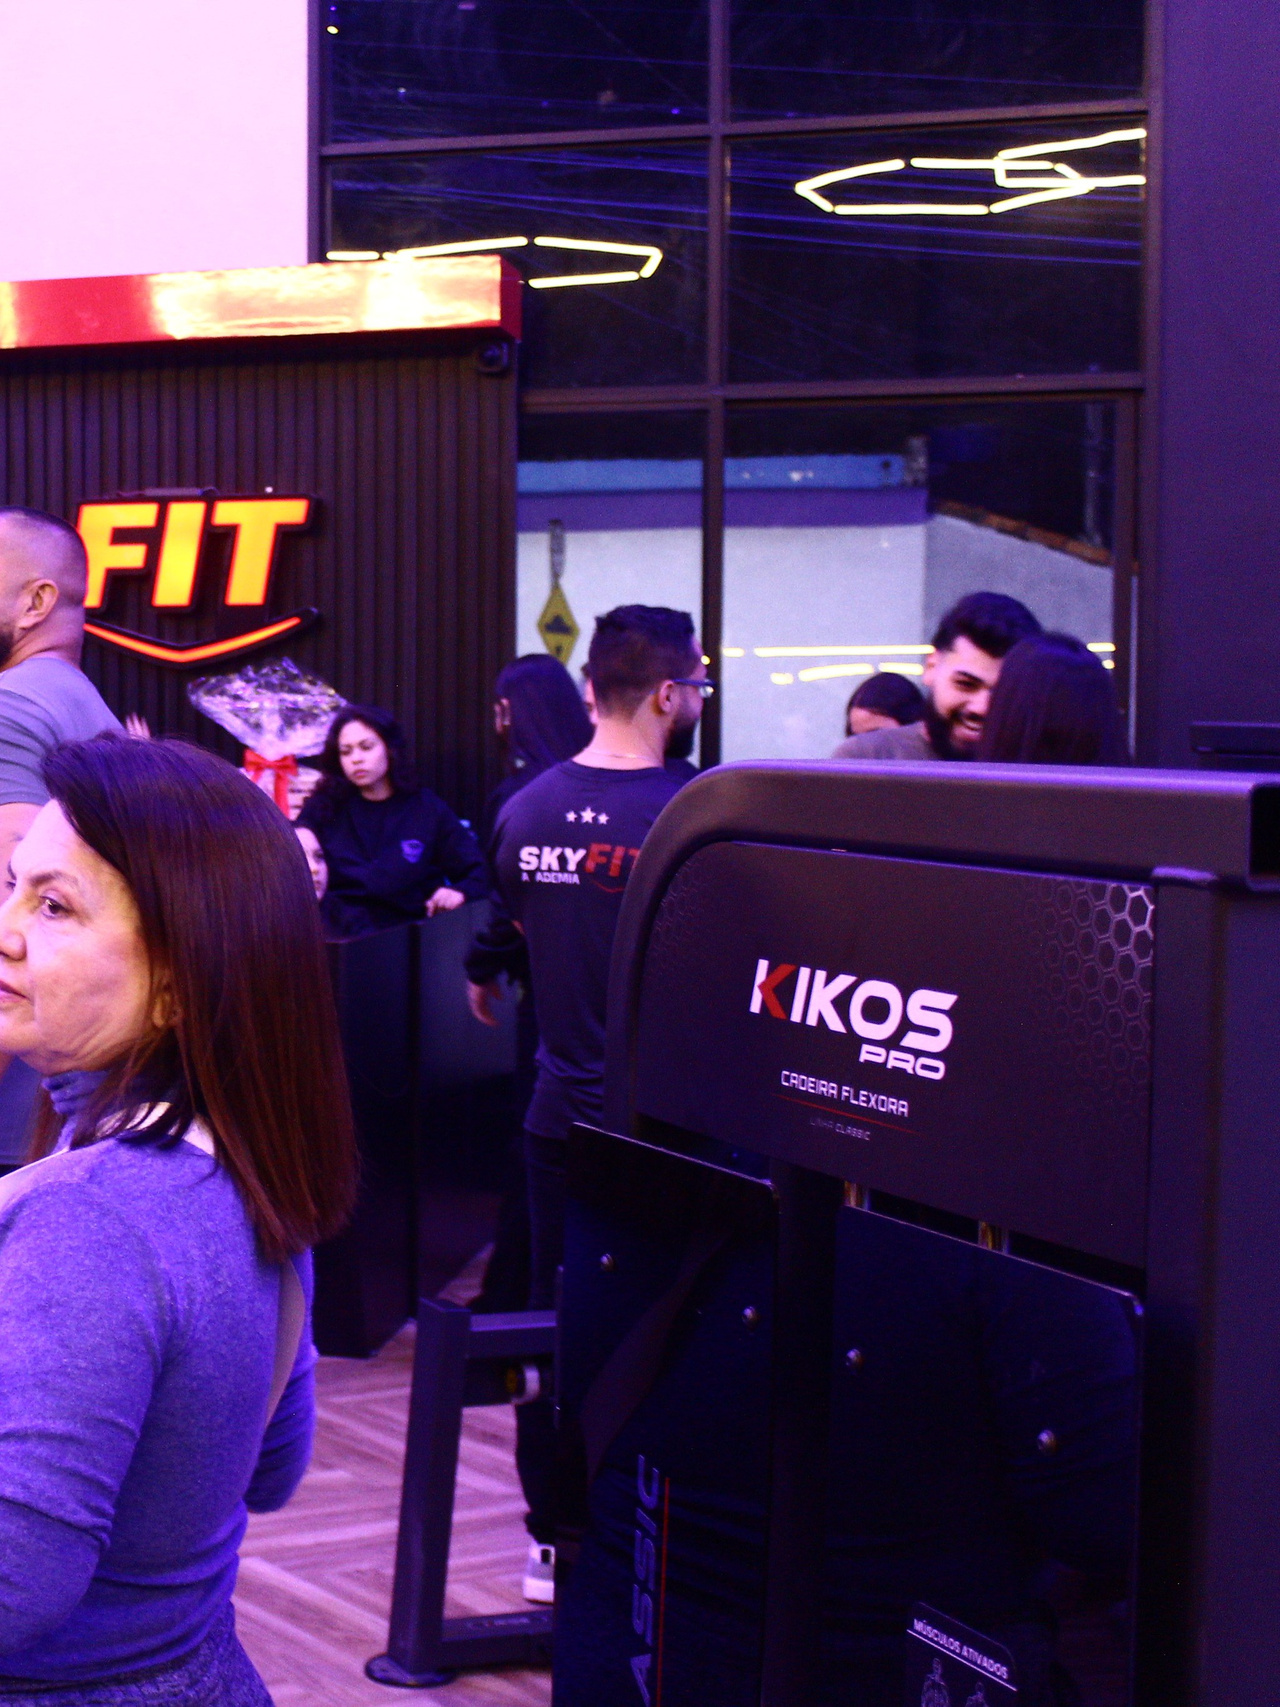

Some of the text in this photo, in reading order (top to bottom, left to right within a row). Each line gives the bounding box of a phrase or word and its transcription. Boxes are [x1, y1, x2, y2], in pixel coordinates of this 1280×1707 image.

[78, 499, 309, 608] FIT
[749, 958, 959, 1053] KIKOS
[858, 1043, 946, 1081] PRO
[780, 1070, 909, 1118] CADEIRA FLEXORA
[913, 1618, 1009, 1680] MÚSCULOS ATIVADOS
